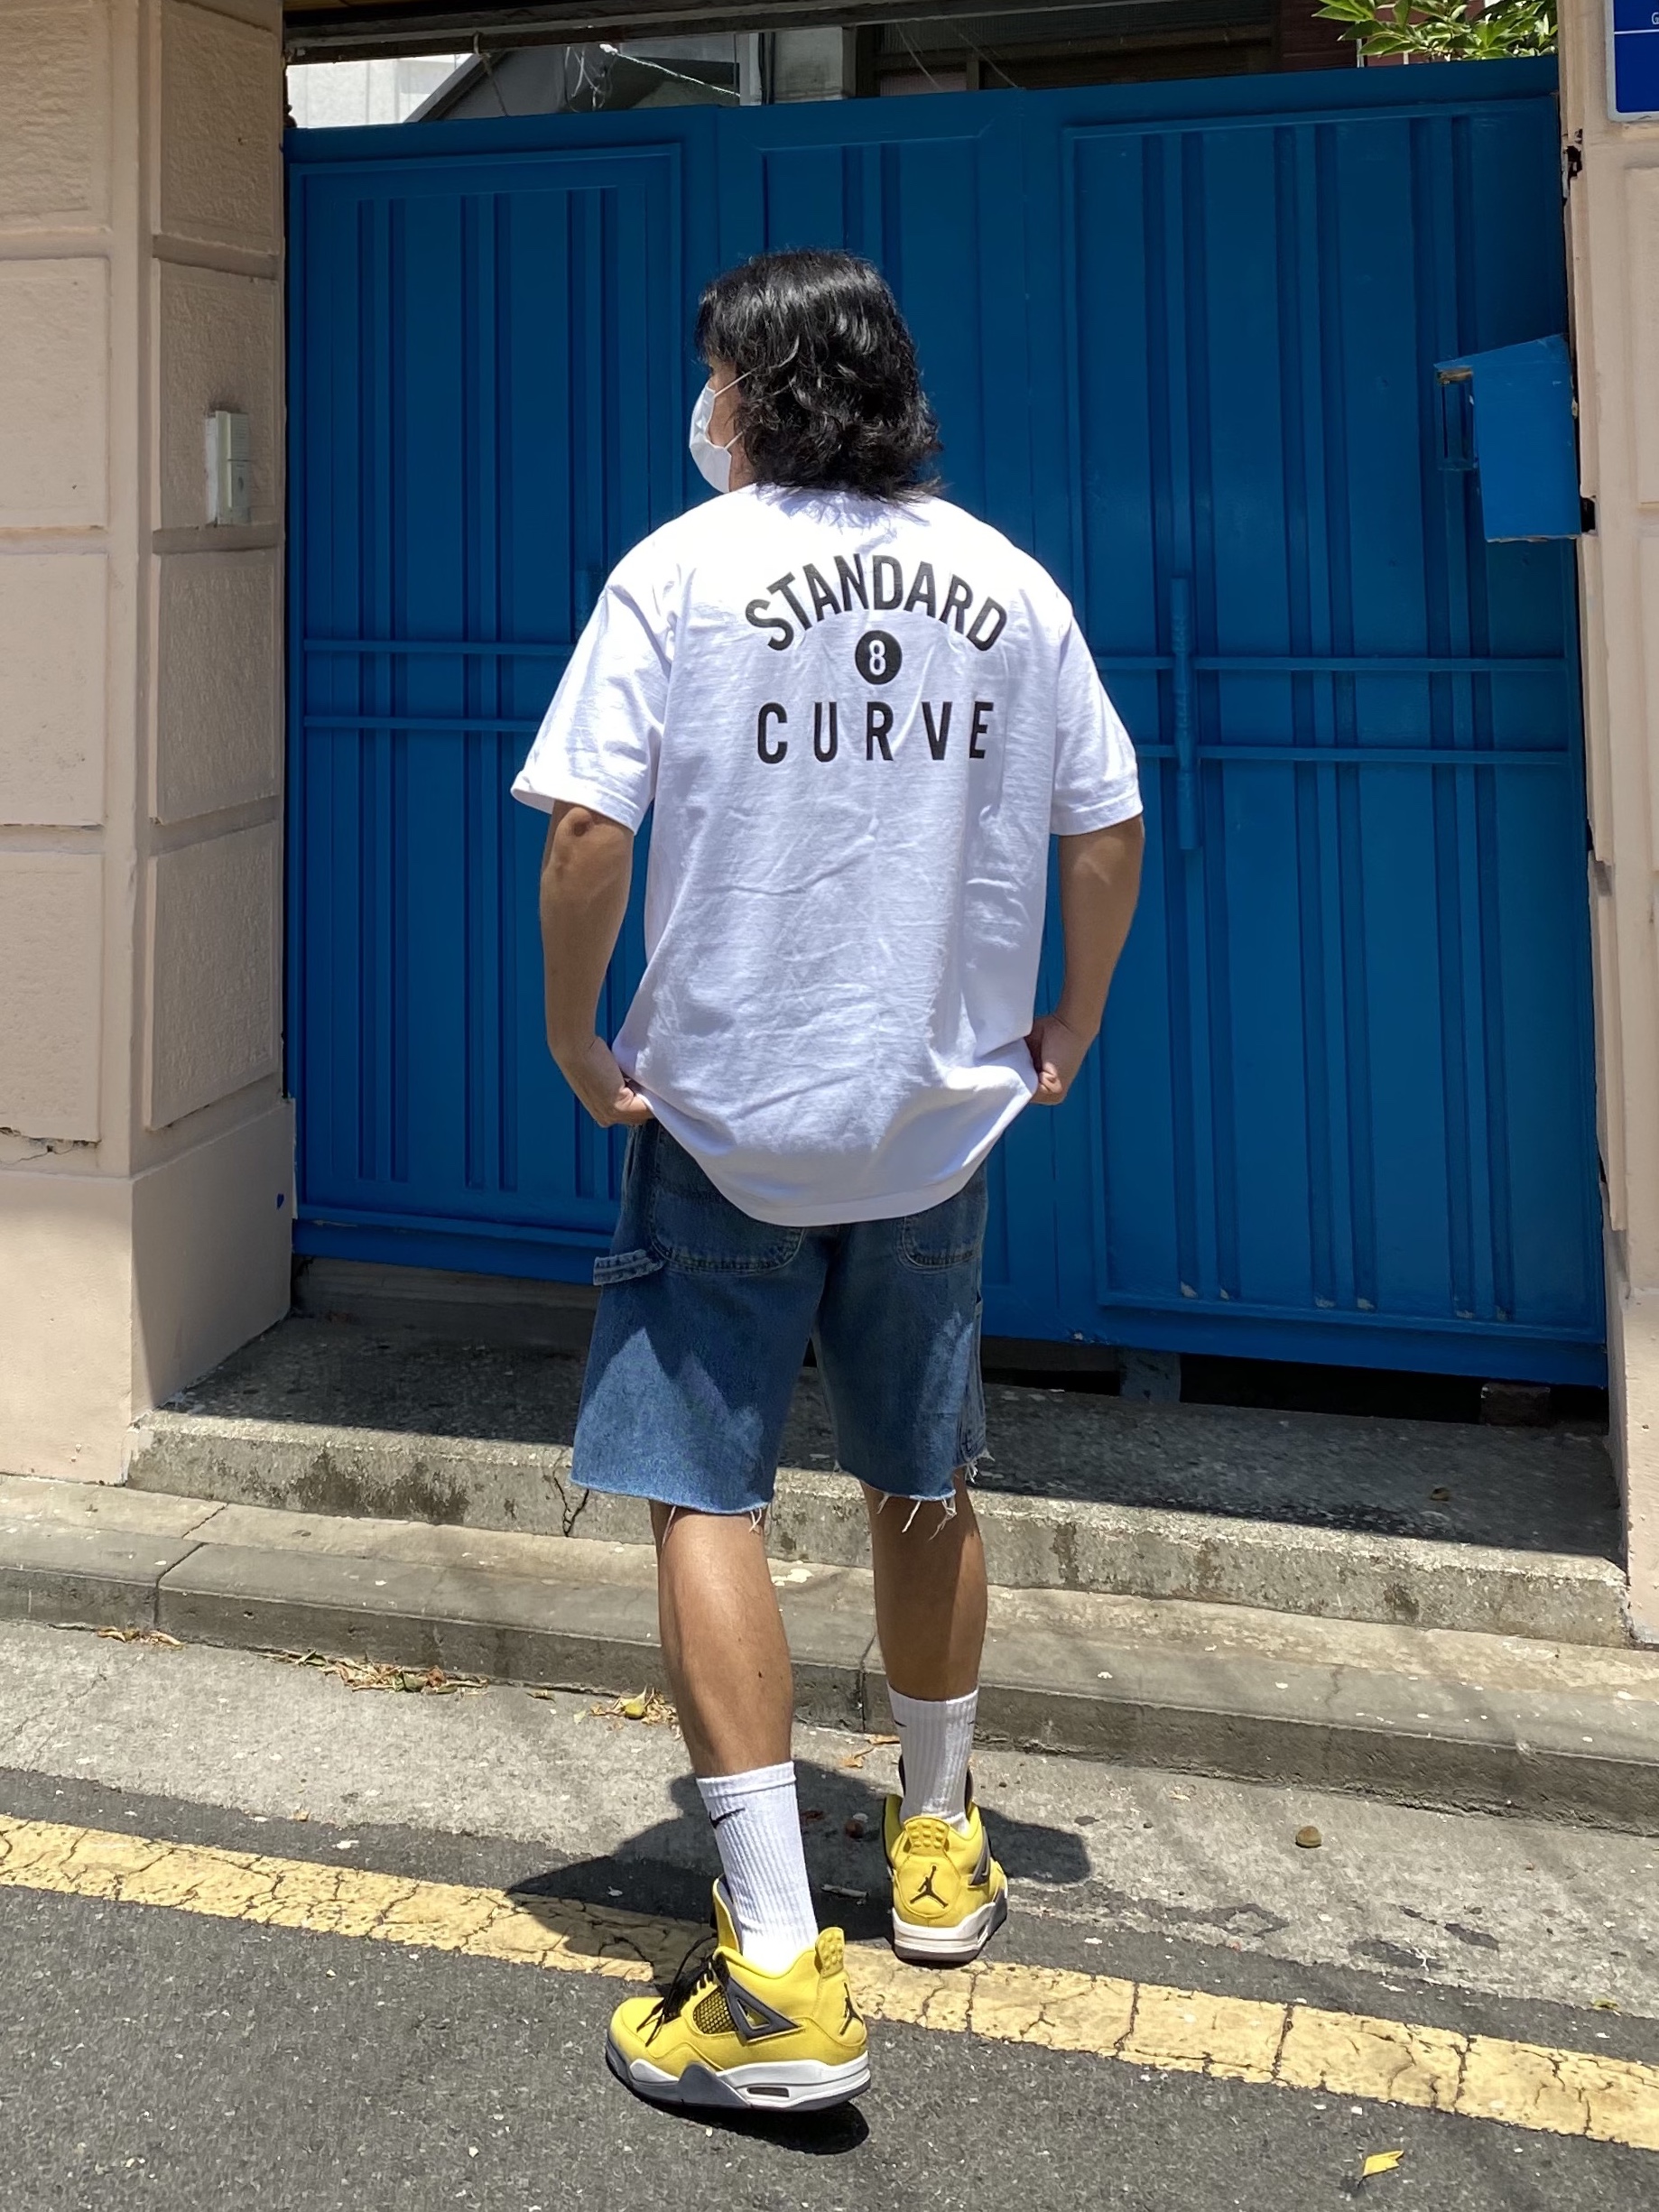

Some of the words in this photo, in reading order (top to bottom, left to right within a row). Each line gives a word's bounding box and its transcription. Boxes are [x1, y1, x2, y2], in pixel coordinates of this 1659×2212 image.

[746, 553, 1007, 652] STANDARD
[867, 638, 887, 676] 8
[757, 701, 994, 764] CURVE
